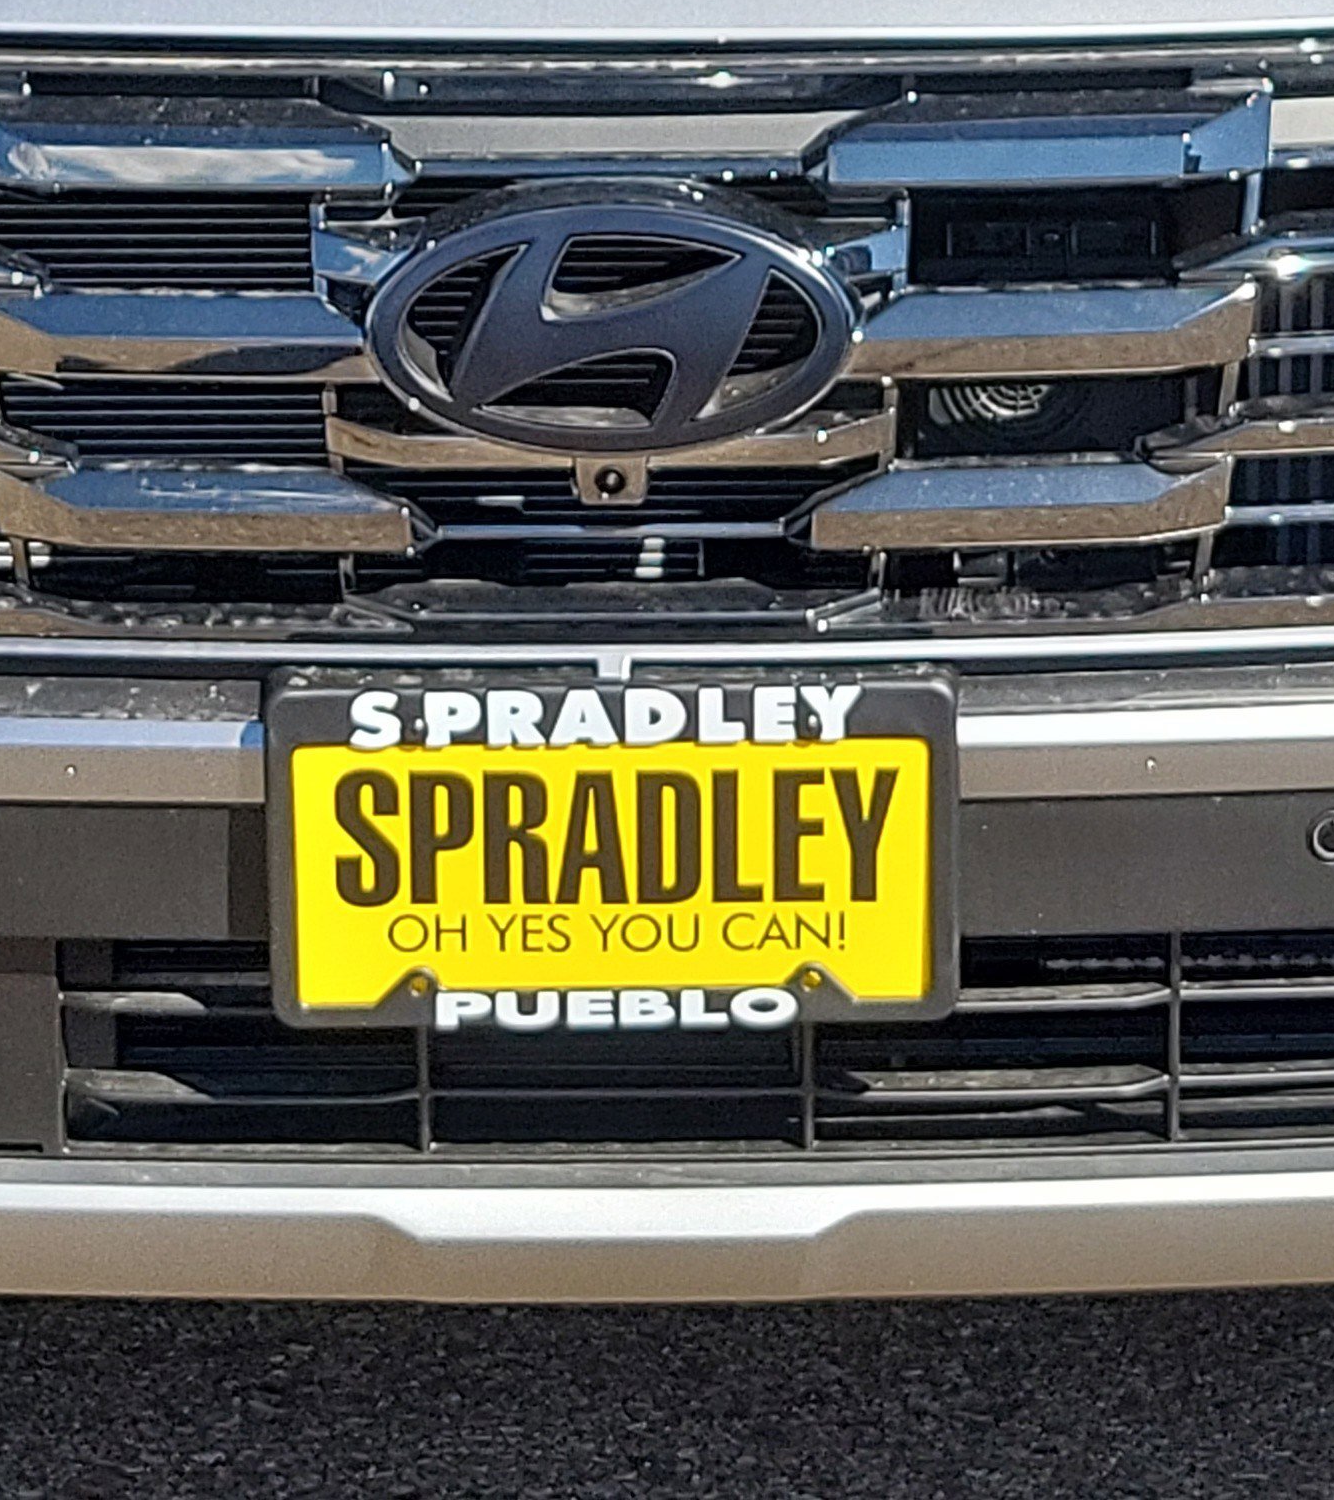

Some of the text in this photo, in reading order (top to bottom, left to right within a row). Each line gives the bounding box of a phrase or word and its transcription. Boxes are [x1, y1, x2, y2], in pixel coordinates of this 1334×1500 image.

[349, 684, 863, 750] SPRADLEY
[334, 768, 900, 908] SPRADLEY
[387, 912, 846, 954] OH YES YOU CAN!
[435, 987, 798, 1030] PUEBLO
